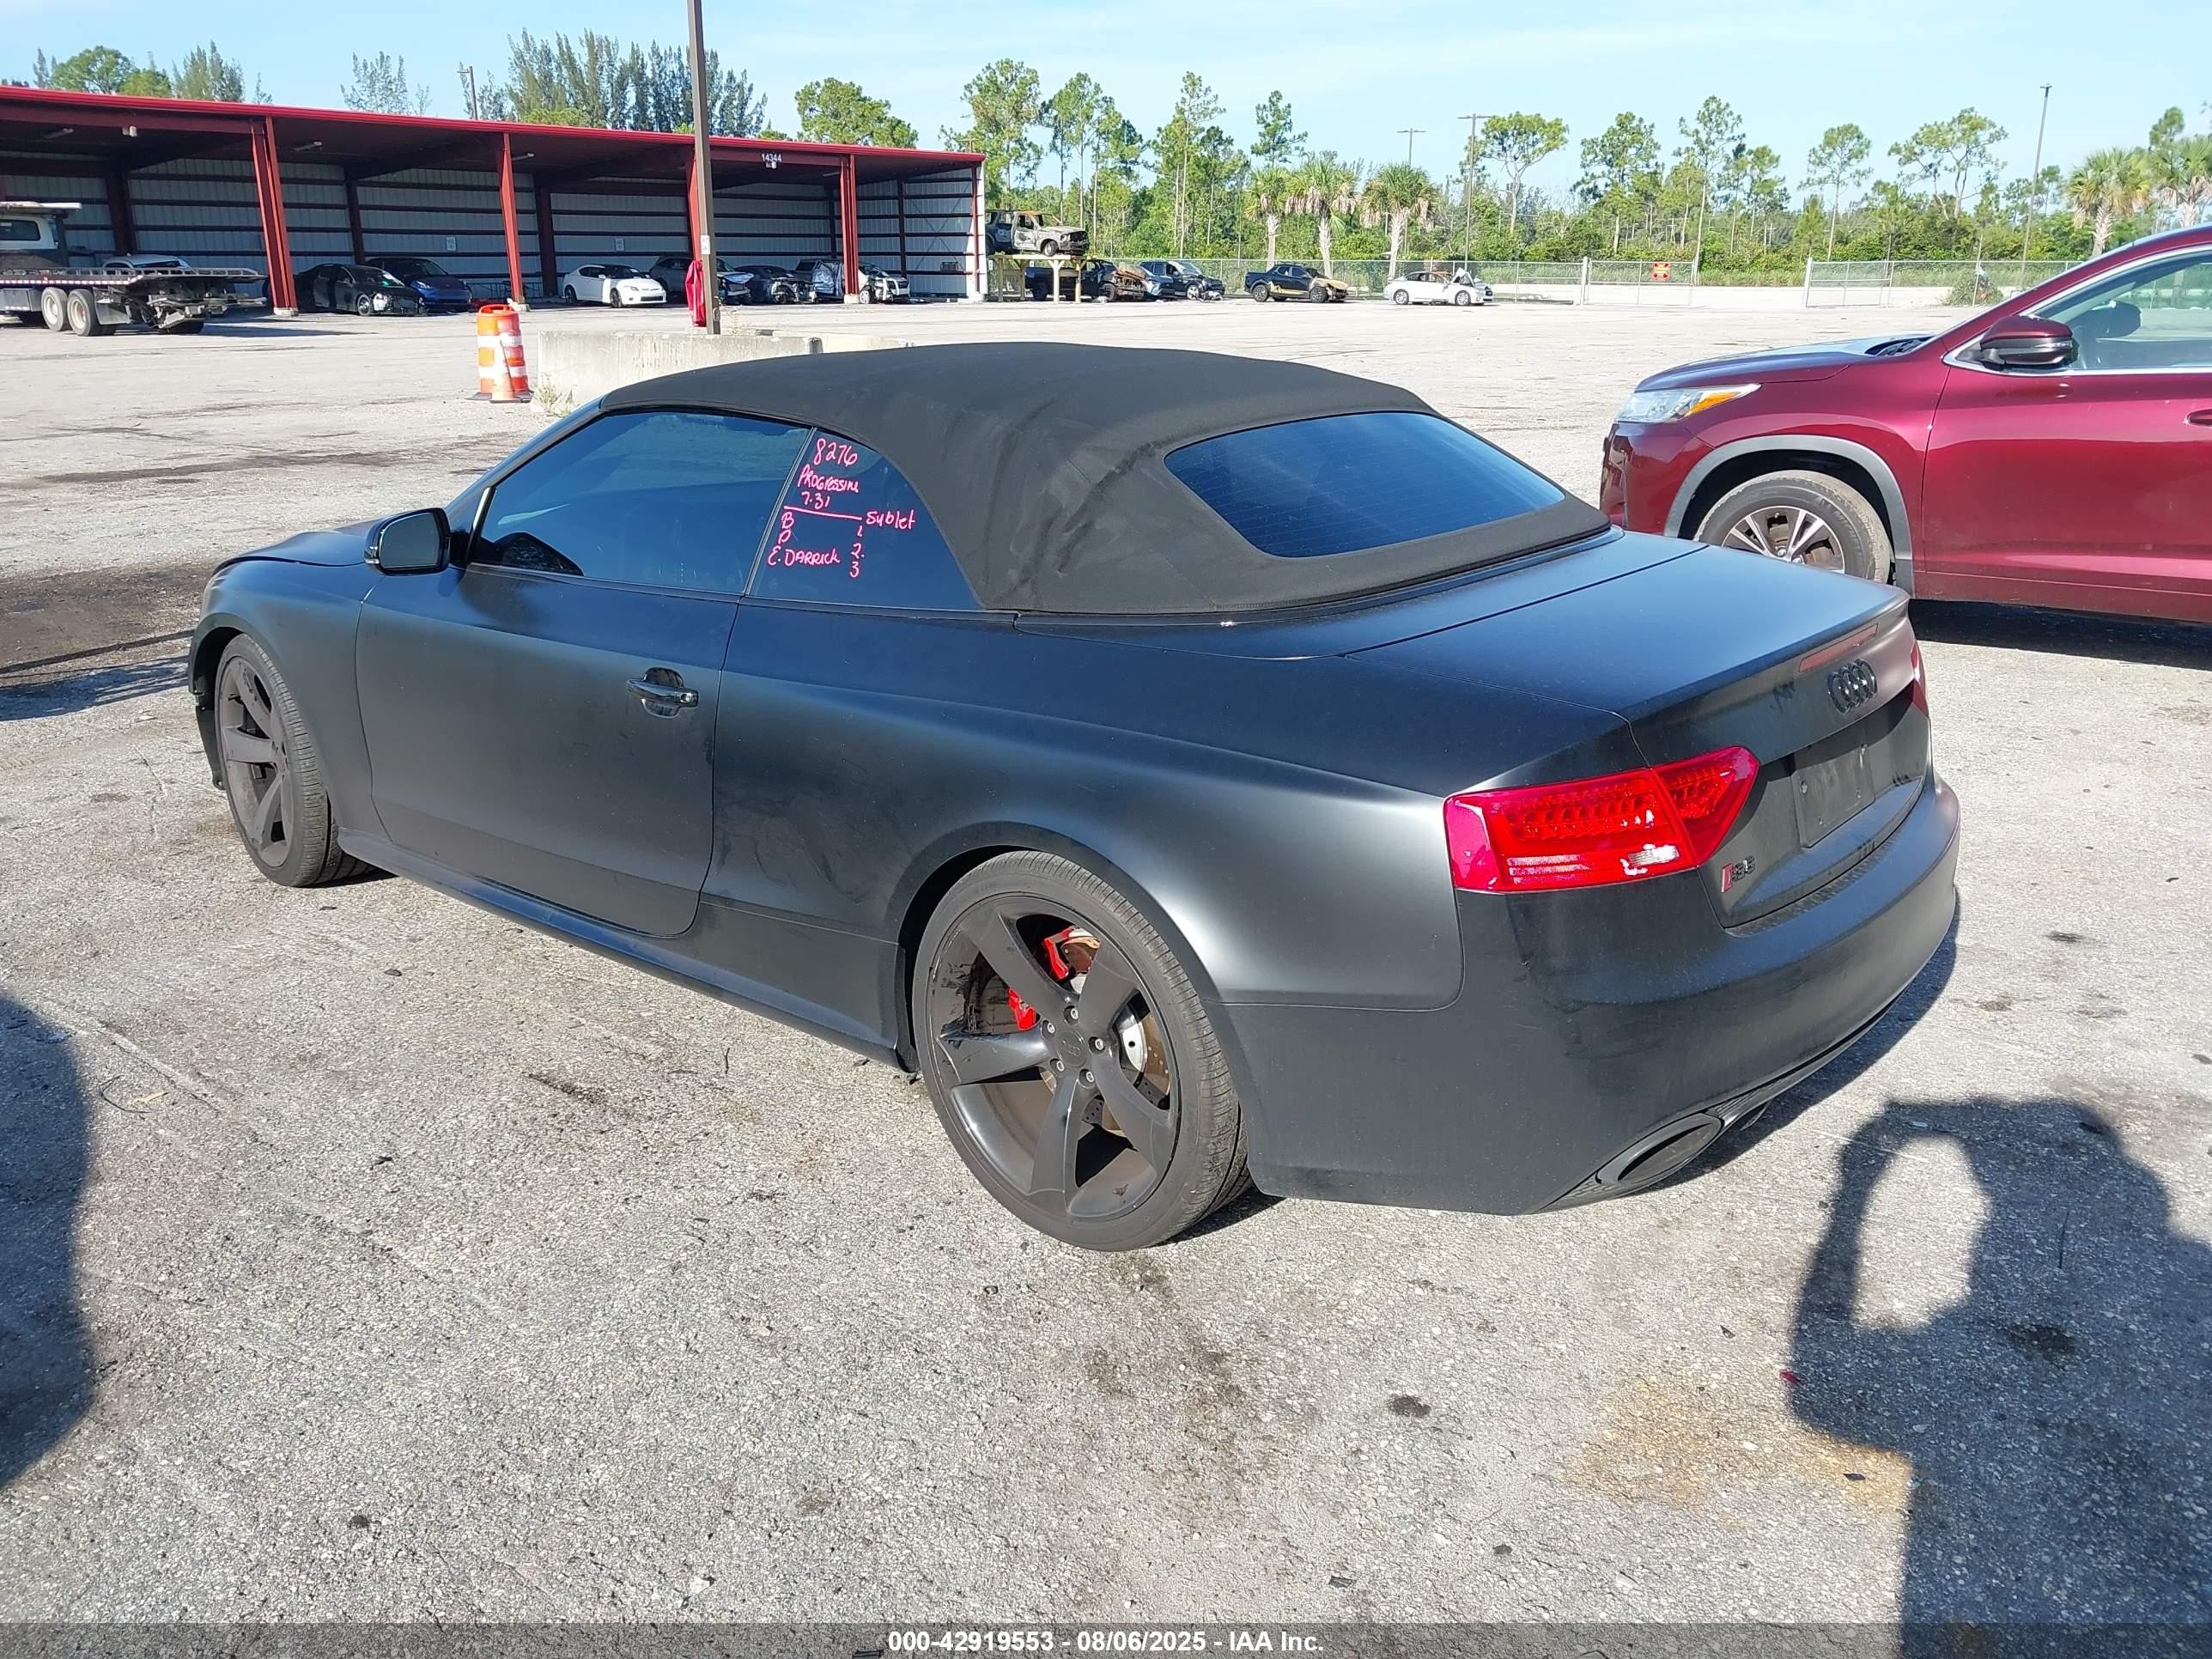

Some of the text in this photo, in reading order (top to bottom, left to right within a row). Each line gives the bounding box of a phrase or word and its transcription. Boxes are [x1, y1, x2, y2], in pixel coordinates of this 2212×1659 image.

[761, 153, 782, 162] 14344
[813, 437, 858, 467] 8276
[781, 511, 795, 530] B
[849, 561, 860, 578] 3
